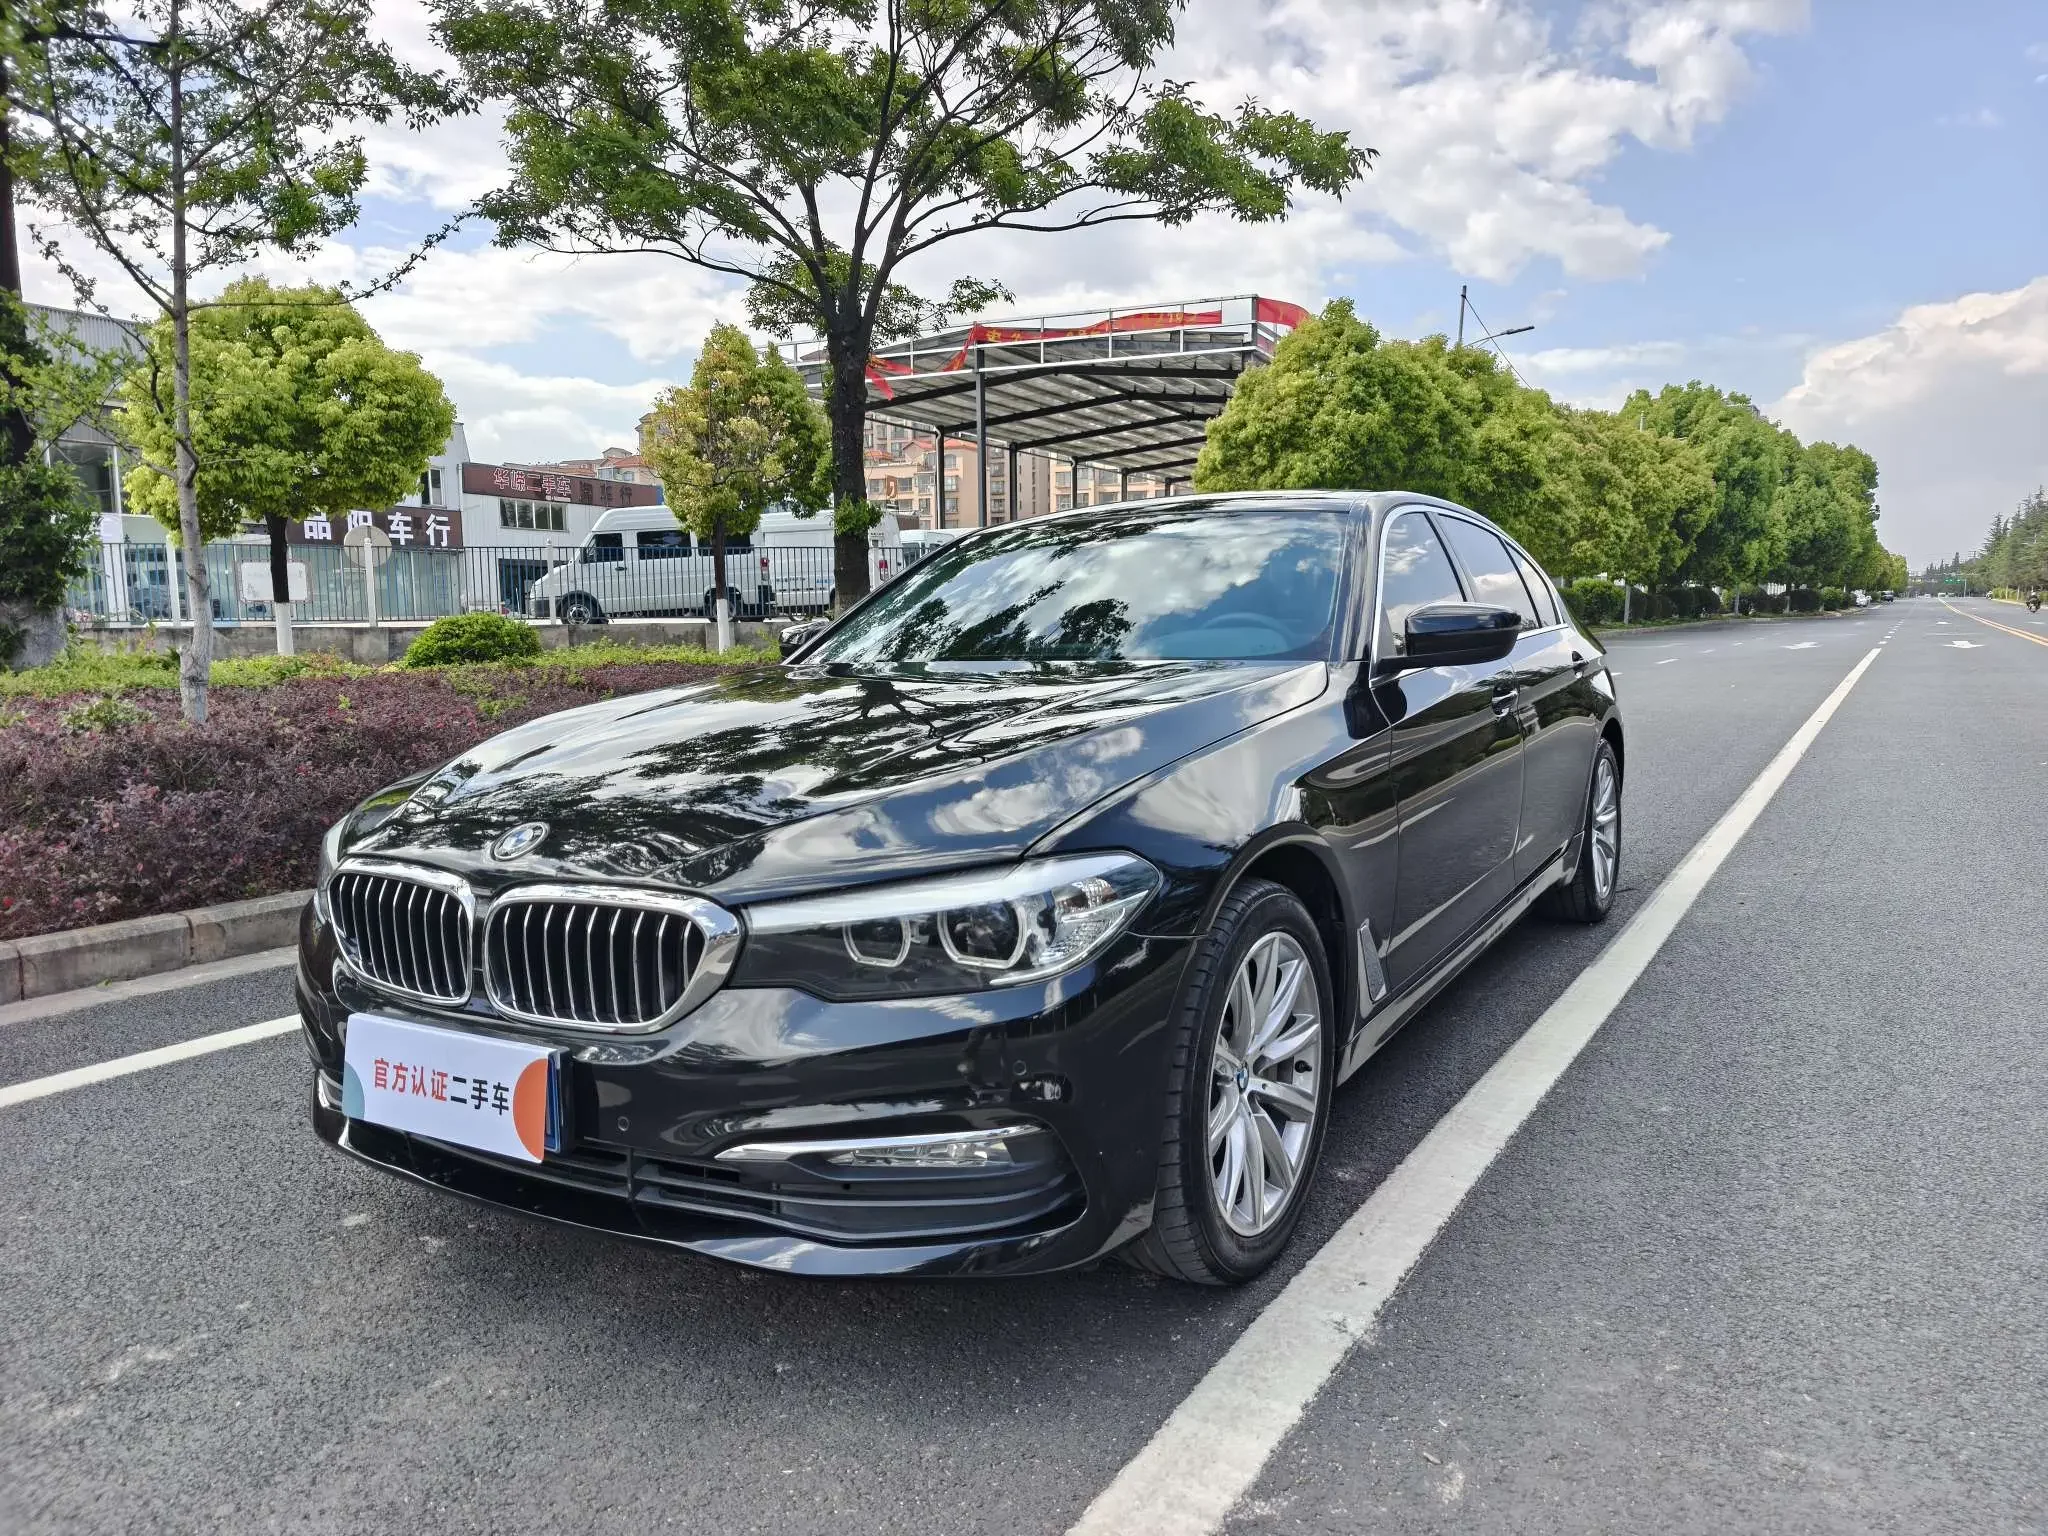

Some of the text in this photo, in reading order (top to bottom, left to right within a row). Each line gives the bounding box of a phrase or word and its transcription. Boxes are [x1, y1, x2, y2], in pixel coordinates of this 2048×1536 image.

[373, 1057, 510, 1116] 官方认证二手车
